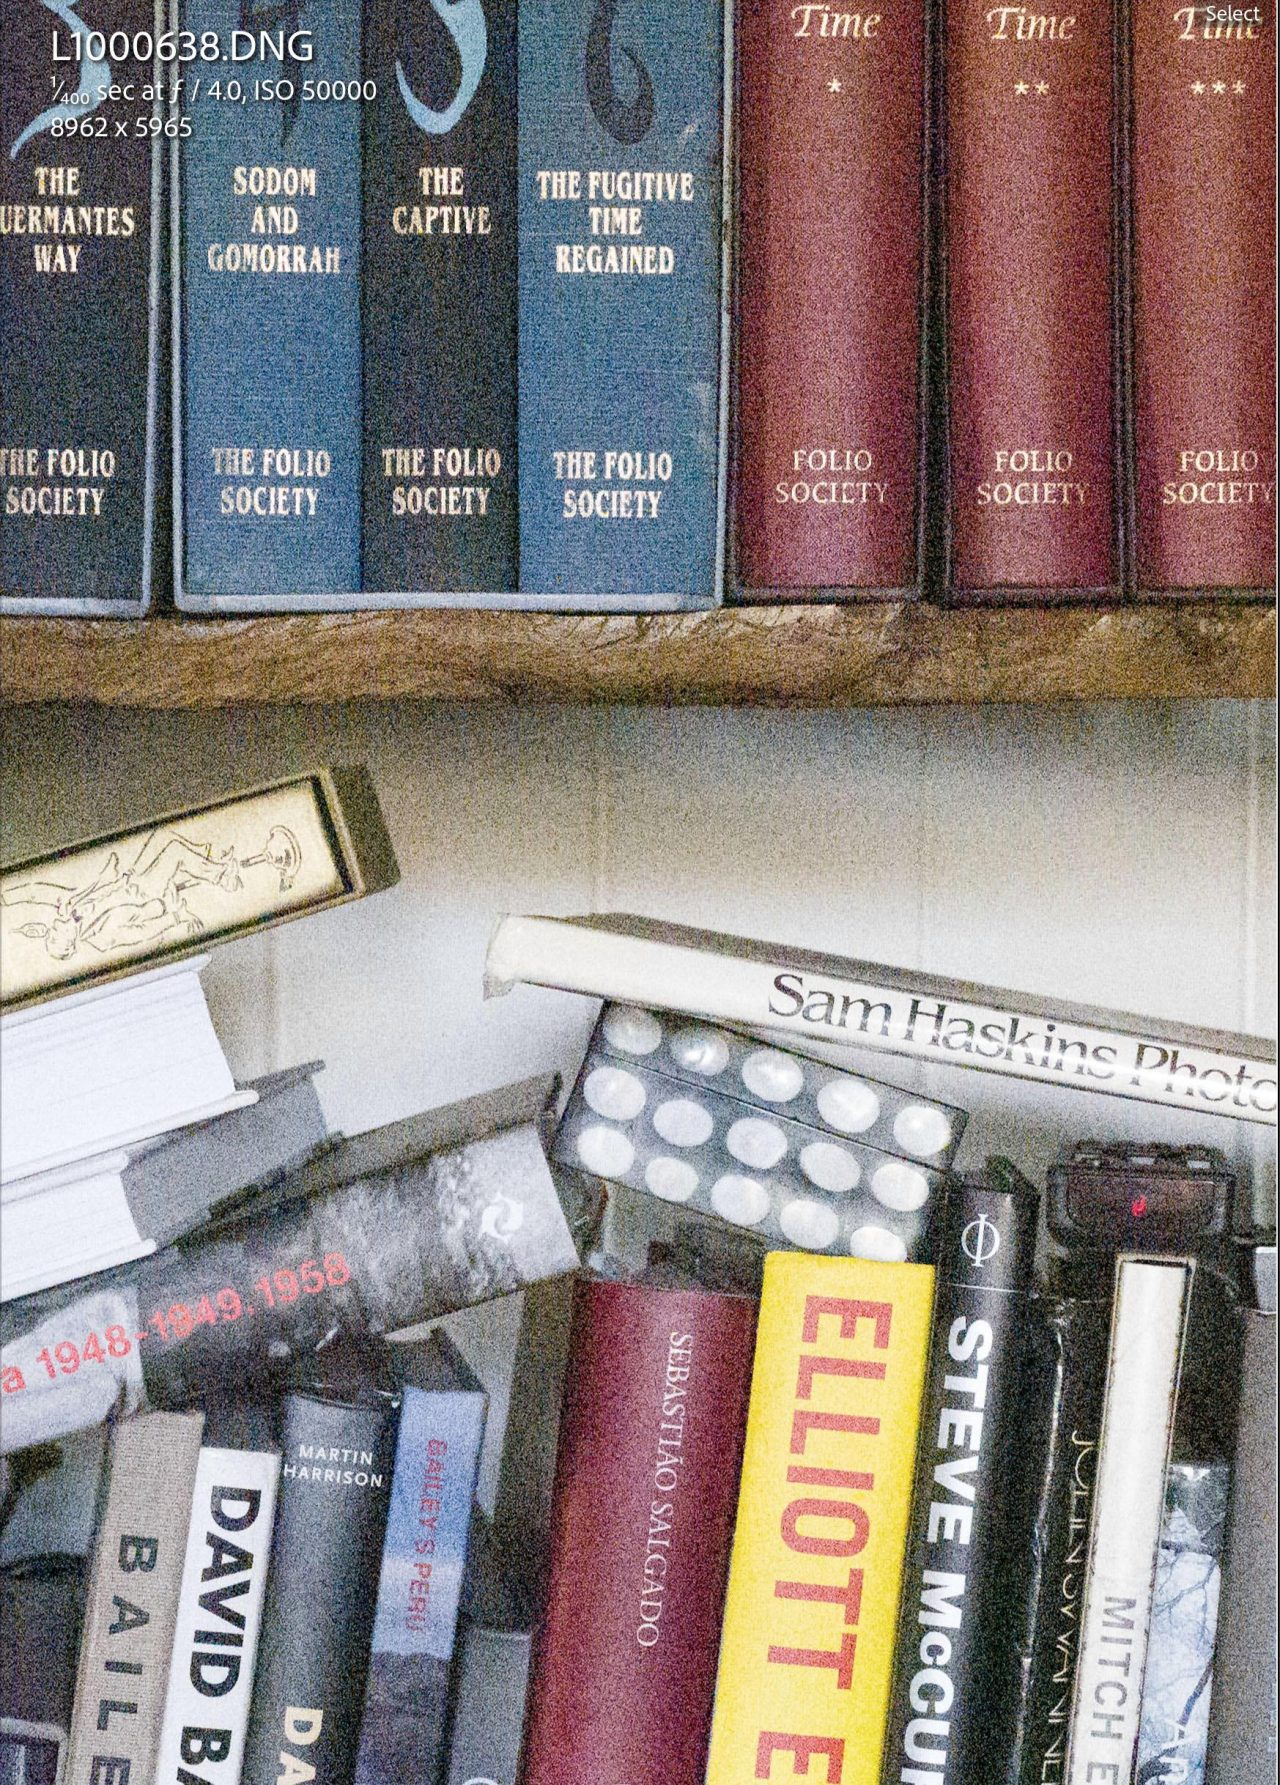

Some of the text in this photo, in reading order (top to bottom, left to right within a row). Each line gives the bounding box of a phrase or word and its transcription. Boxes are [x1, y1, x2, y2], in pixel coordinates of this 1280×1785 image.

[791, 4, 881, 39] Time
[987, 6, 1076, 41] Time
[35, 166, 80, 197] THE
[233, 166, 317, 197] SODOM
[419, 167, 464, 197] THE
[537, 171, 694, 201] THE FUGITIVE
[0, 204, 135, 237] UERMANTES
[251, 206, 299, 235] AND
[392, 206, 492, 236] CAPTIVE
[590, 208, 643, 235] TIME
[34, 244, 81, 273] WAY
[208, 244, 341, 274] GOMORRAH
[556, 244, 674, 274] REGAINED
[0, 448, 115, 477] THE FOLIO
[212, 448, 331, 477] THE FOLIO
[382, 448, 501, 477] THE FOLIO
[553, 451, 673, 481] THE FOLIO
[792, 450, 872, 472] FOLIO
[994, 450, 1073, 473] FOLIO
[1179, 450, 1258, 473] FOLIO
[6, 485, 104, 516] SOCIETY
[220, 487, 320, 516] SOCIETY
[391, 487, 491, 516] SOCIETY
[561, 489, 663, 519] SOCIETY
[775, 482, 889, 504] SOCIETY
[977, 483, 1090, 505] SOCIETY
[1163, 483, 1276, 505] SOCIETY
[767, 972, 1278, 1113] Sam Haskins Photo
[0, 1366, 26, 1394] a
[926, 1315, 994, 1546] STEVE
[298, 1444, 373, 1466] MARTIN
[283, 1464, 384, 1488] HARRISON
[636, 1331, 693, 1649] SEBASTIÃO SALGADO
[754, 1294, 894, 1785] ELLIOTT E
[189, 1485, 262, 1698] DAVID
[404, 1562, 434, 1633] PERU
[89, 1533, 159, 1785] BAILE
[1090, 1596, 1137, 1740] MITCH
